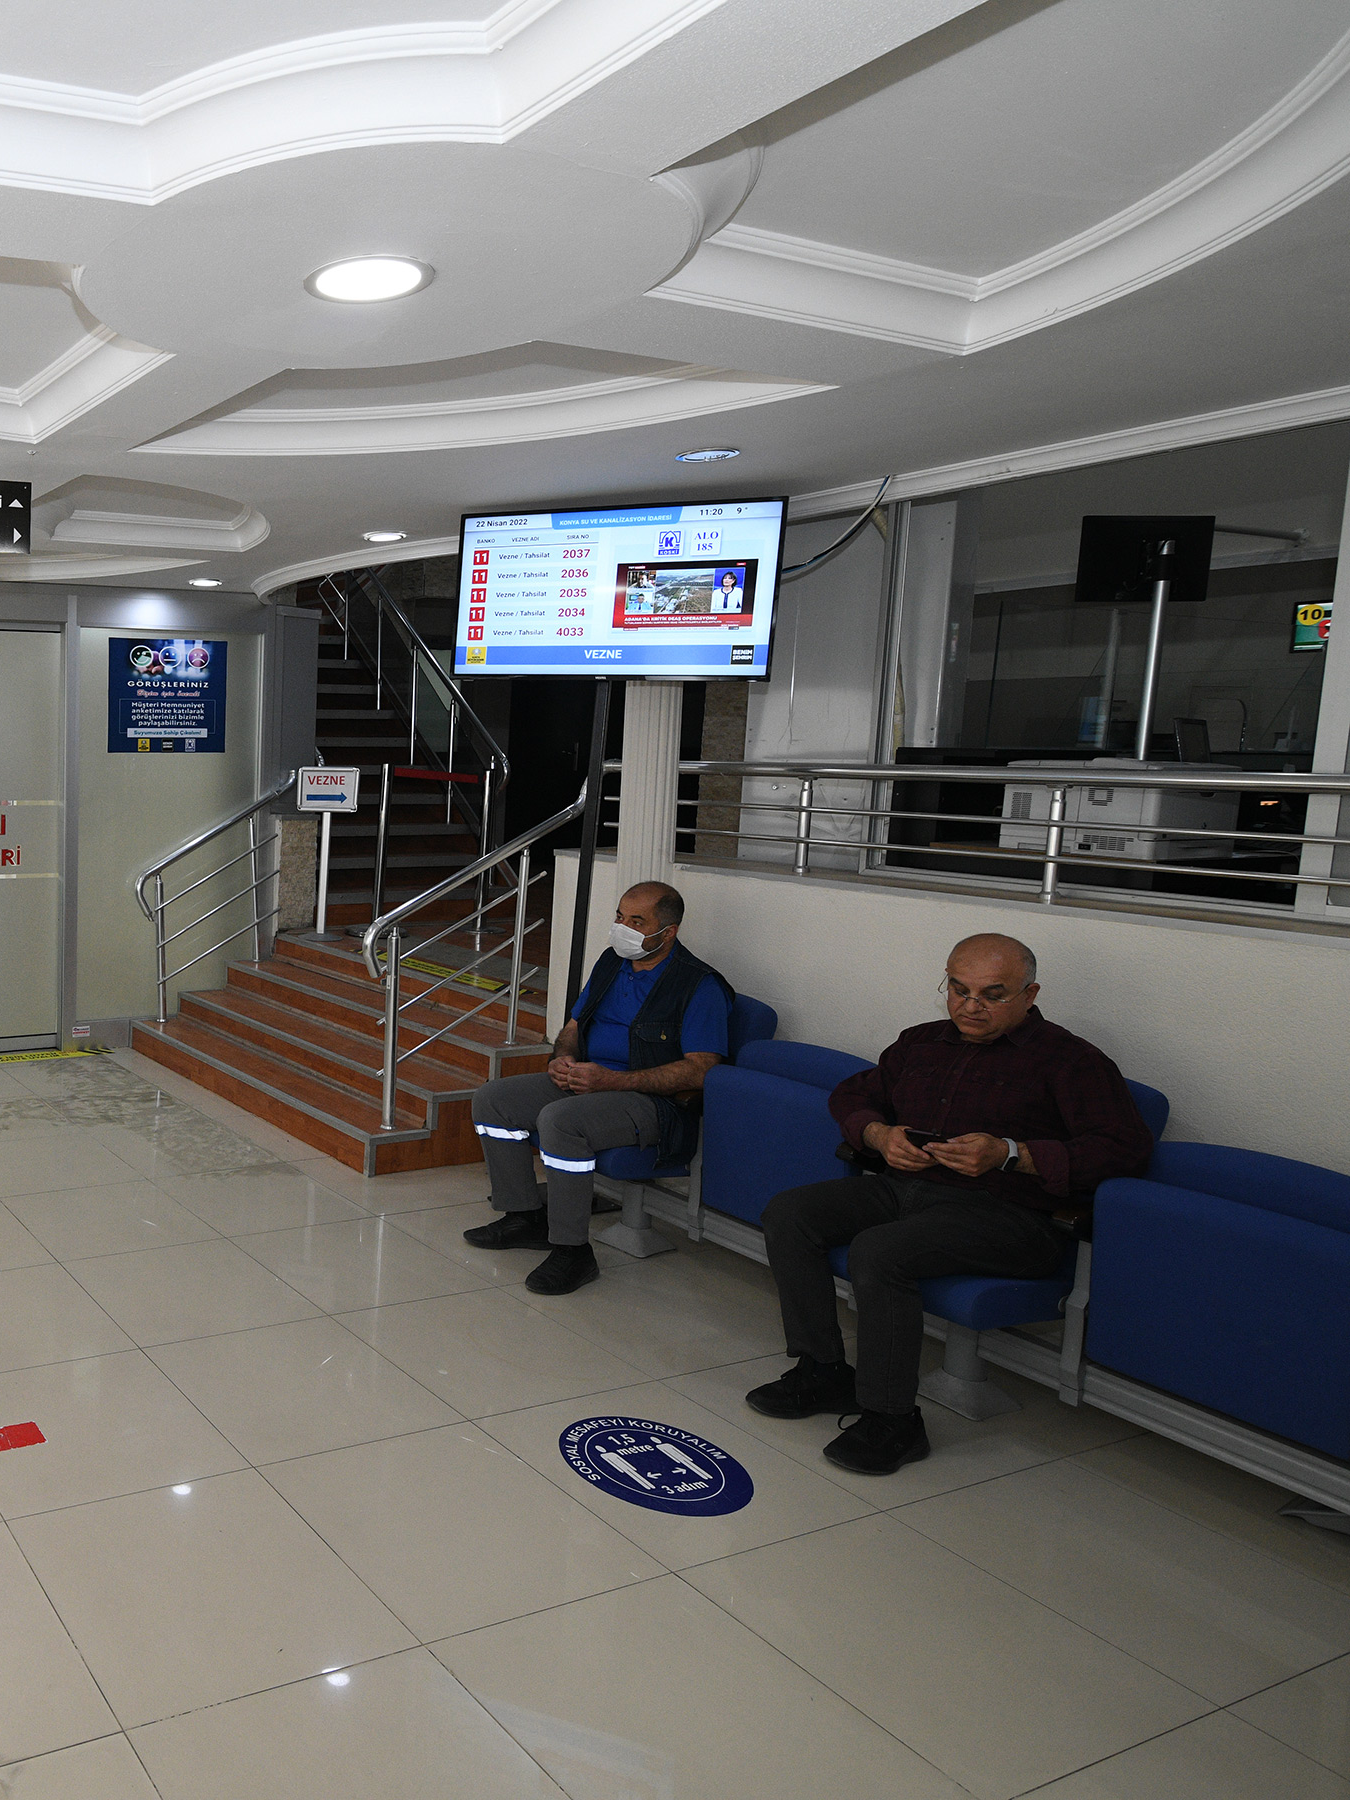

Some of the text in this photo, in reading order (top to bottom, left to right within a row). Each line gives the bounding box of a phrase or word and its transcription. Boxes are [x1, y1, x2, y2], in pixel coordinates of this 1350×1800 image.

[700, 508, 723, 516] 11:20
[476, 518, 528, 528] 22 Nisan 2022
[599, 516, 646, 524] KANALİZASYON
[694, 531, 719, 540] ALO
[696, 543, 713, 551] 185
[474, 552, 488, 563] 11
[562, 549, 590, 559] 2037
[473, 571, 486, 582] 11
[561, 568, 589, 579] 2036
[472, 590, 485, 601] 11
[559, 588, 587, 598] 2035
[471, 609, 484, 620] 11
[557, 608, 585, 618] 2034
[1300, 609, 1322, 620] 10
[469, 628, 482, 638] 11
[556, 627, 584, 637] 4033
[584, 650, 622, 659] VEZNE
[127, 679, 209, 688] GÖRÜŞLERİNİZ
[131, 701, 159, 709] Müşteri
[307, 775, 346, 786] VEZNE
[607, 1433, 636, 1446] 1,5
[566, 1418, 727, 1481] SOSYAL MESAFEYİ KORUYALIM
[616, 1443, 654, 1456] metre
[661, 1480, 709, 1495] 3 adım
